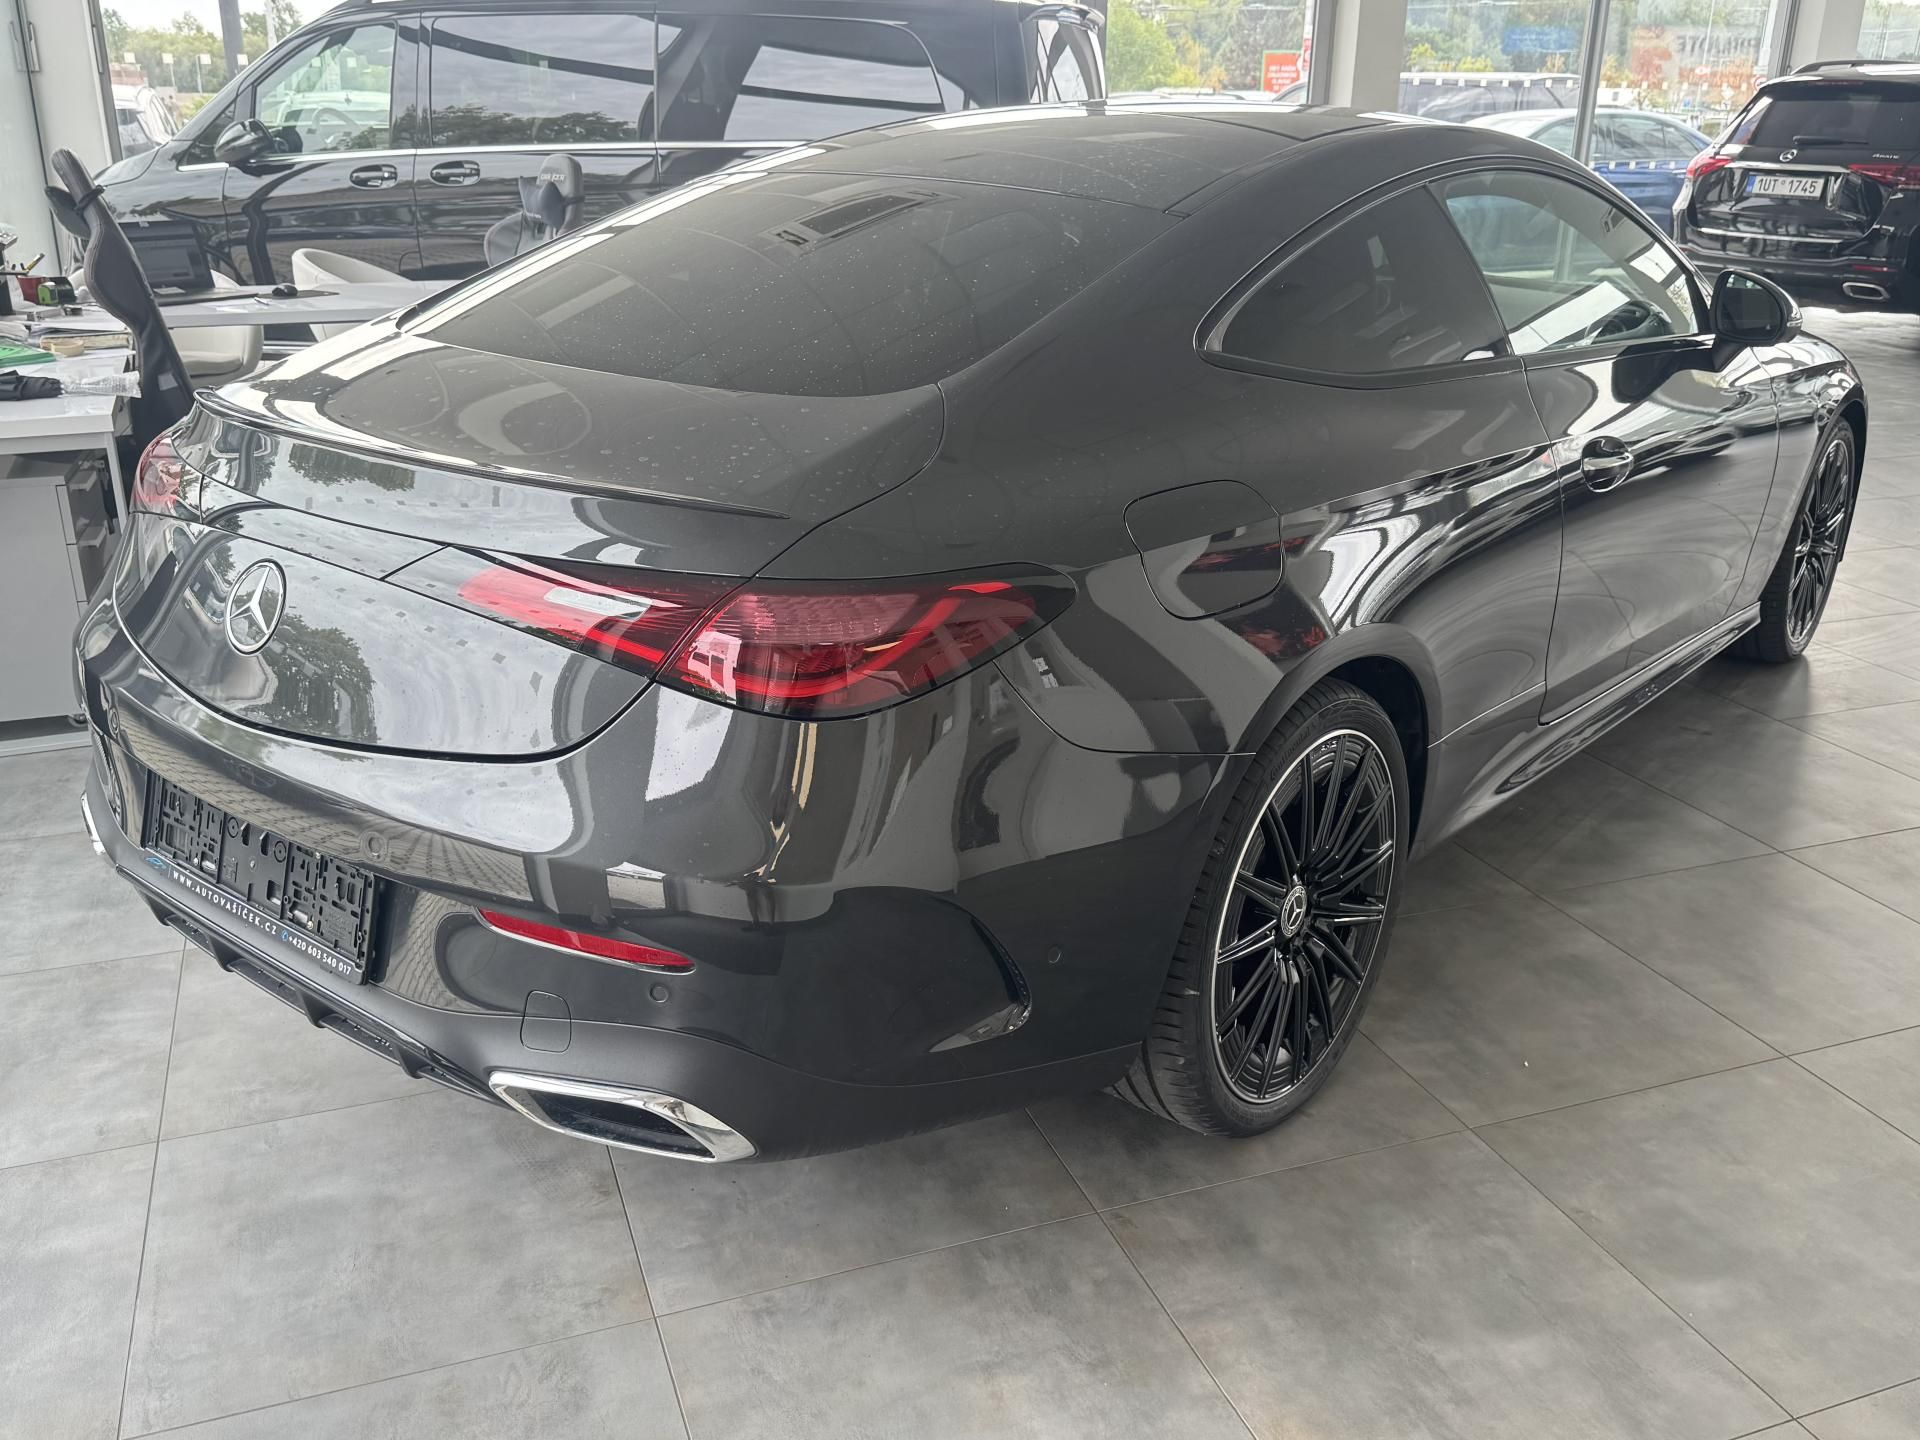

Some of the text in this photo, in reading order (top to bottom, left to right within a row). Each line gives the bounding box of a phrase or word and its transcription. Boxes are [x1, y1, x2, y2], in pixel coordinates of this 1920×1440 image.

[1758, 178, 1819, 194] 1UT 1745
[172, 869, 277, 935] WWW.AUTOVAŠÍČEK.CZ
[288, 936, 307, 951] +420
[307, 945, 322, 960] 603
[322, 953, 337, 968] 540
[338, 962, 352, 976] 017
